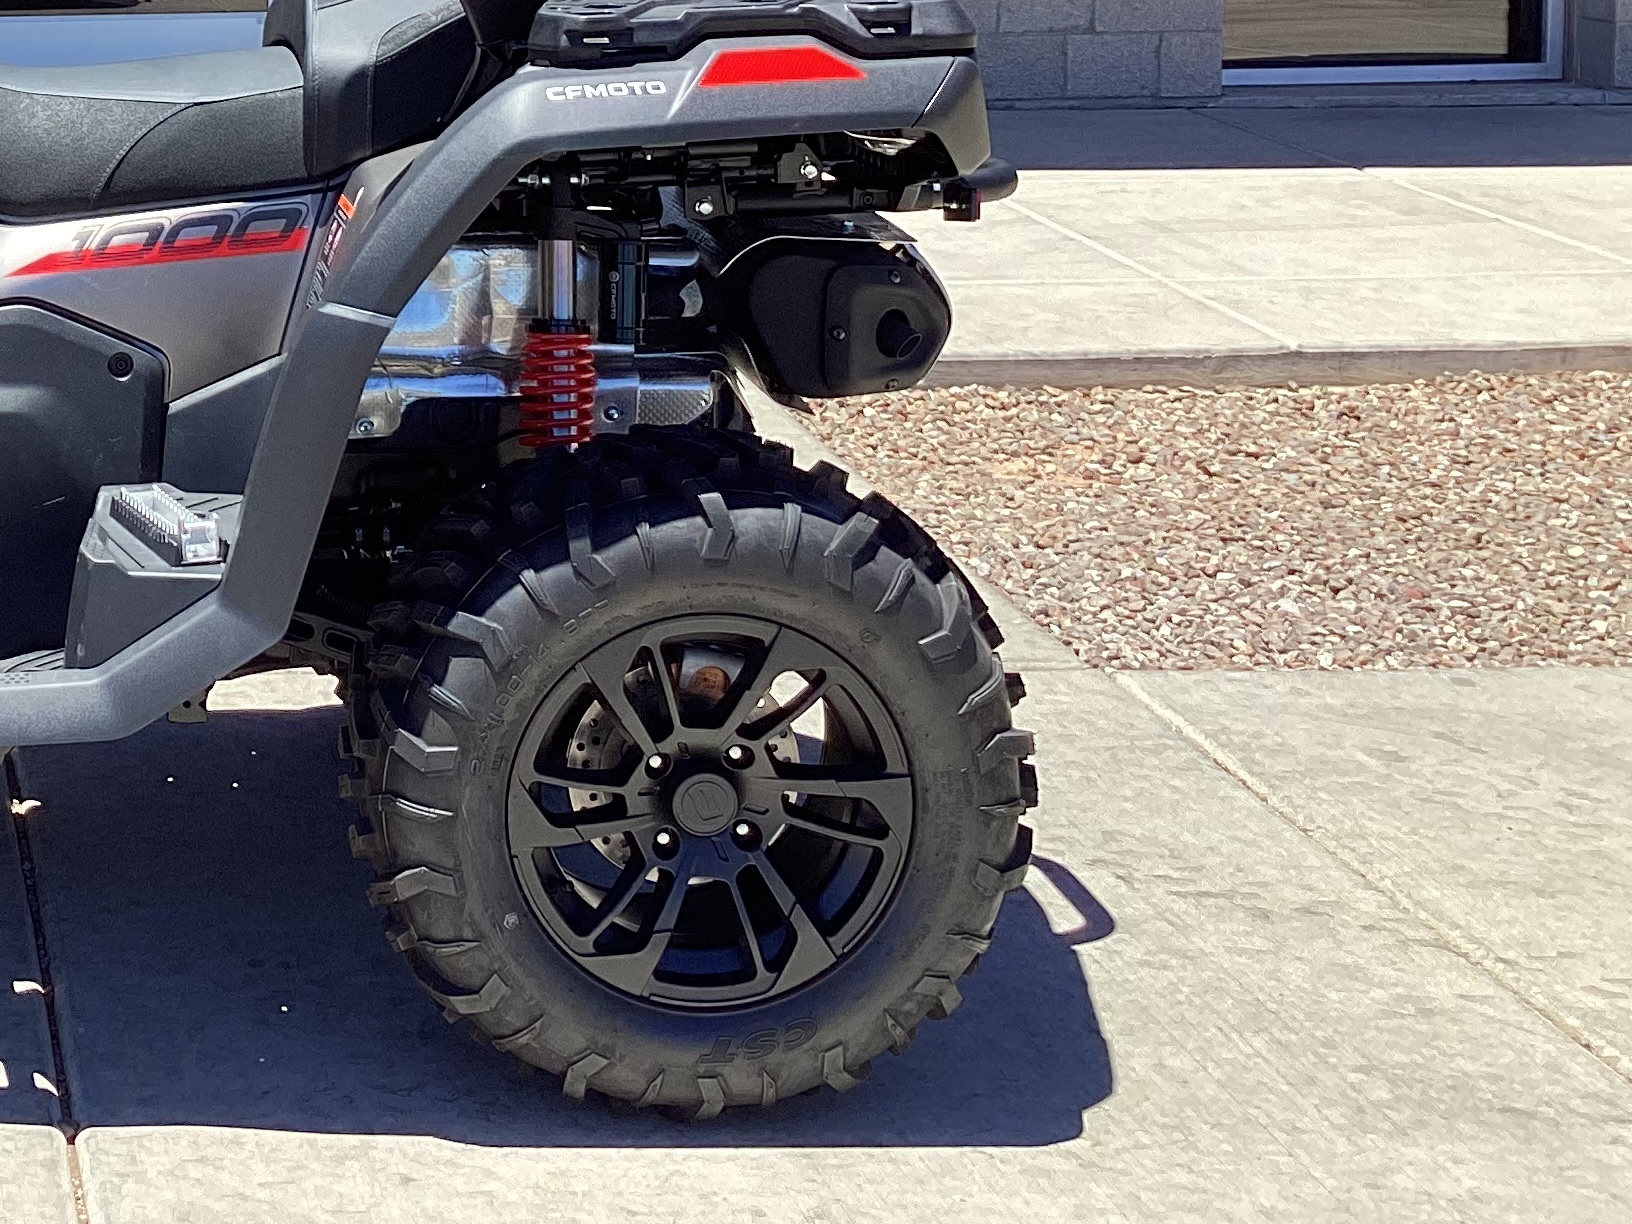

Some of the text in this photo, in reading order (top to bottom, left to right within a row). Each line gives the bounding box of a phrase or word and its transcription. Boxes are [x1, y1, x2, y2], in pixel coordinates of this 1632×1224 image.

[545, 80, 668, 101] CFMOTO
[70, 201, 310, 263] 1000
[697, 1016, 820, 1066] CST
